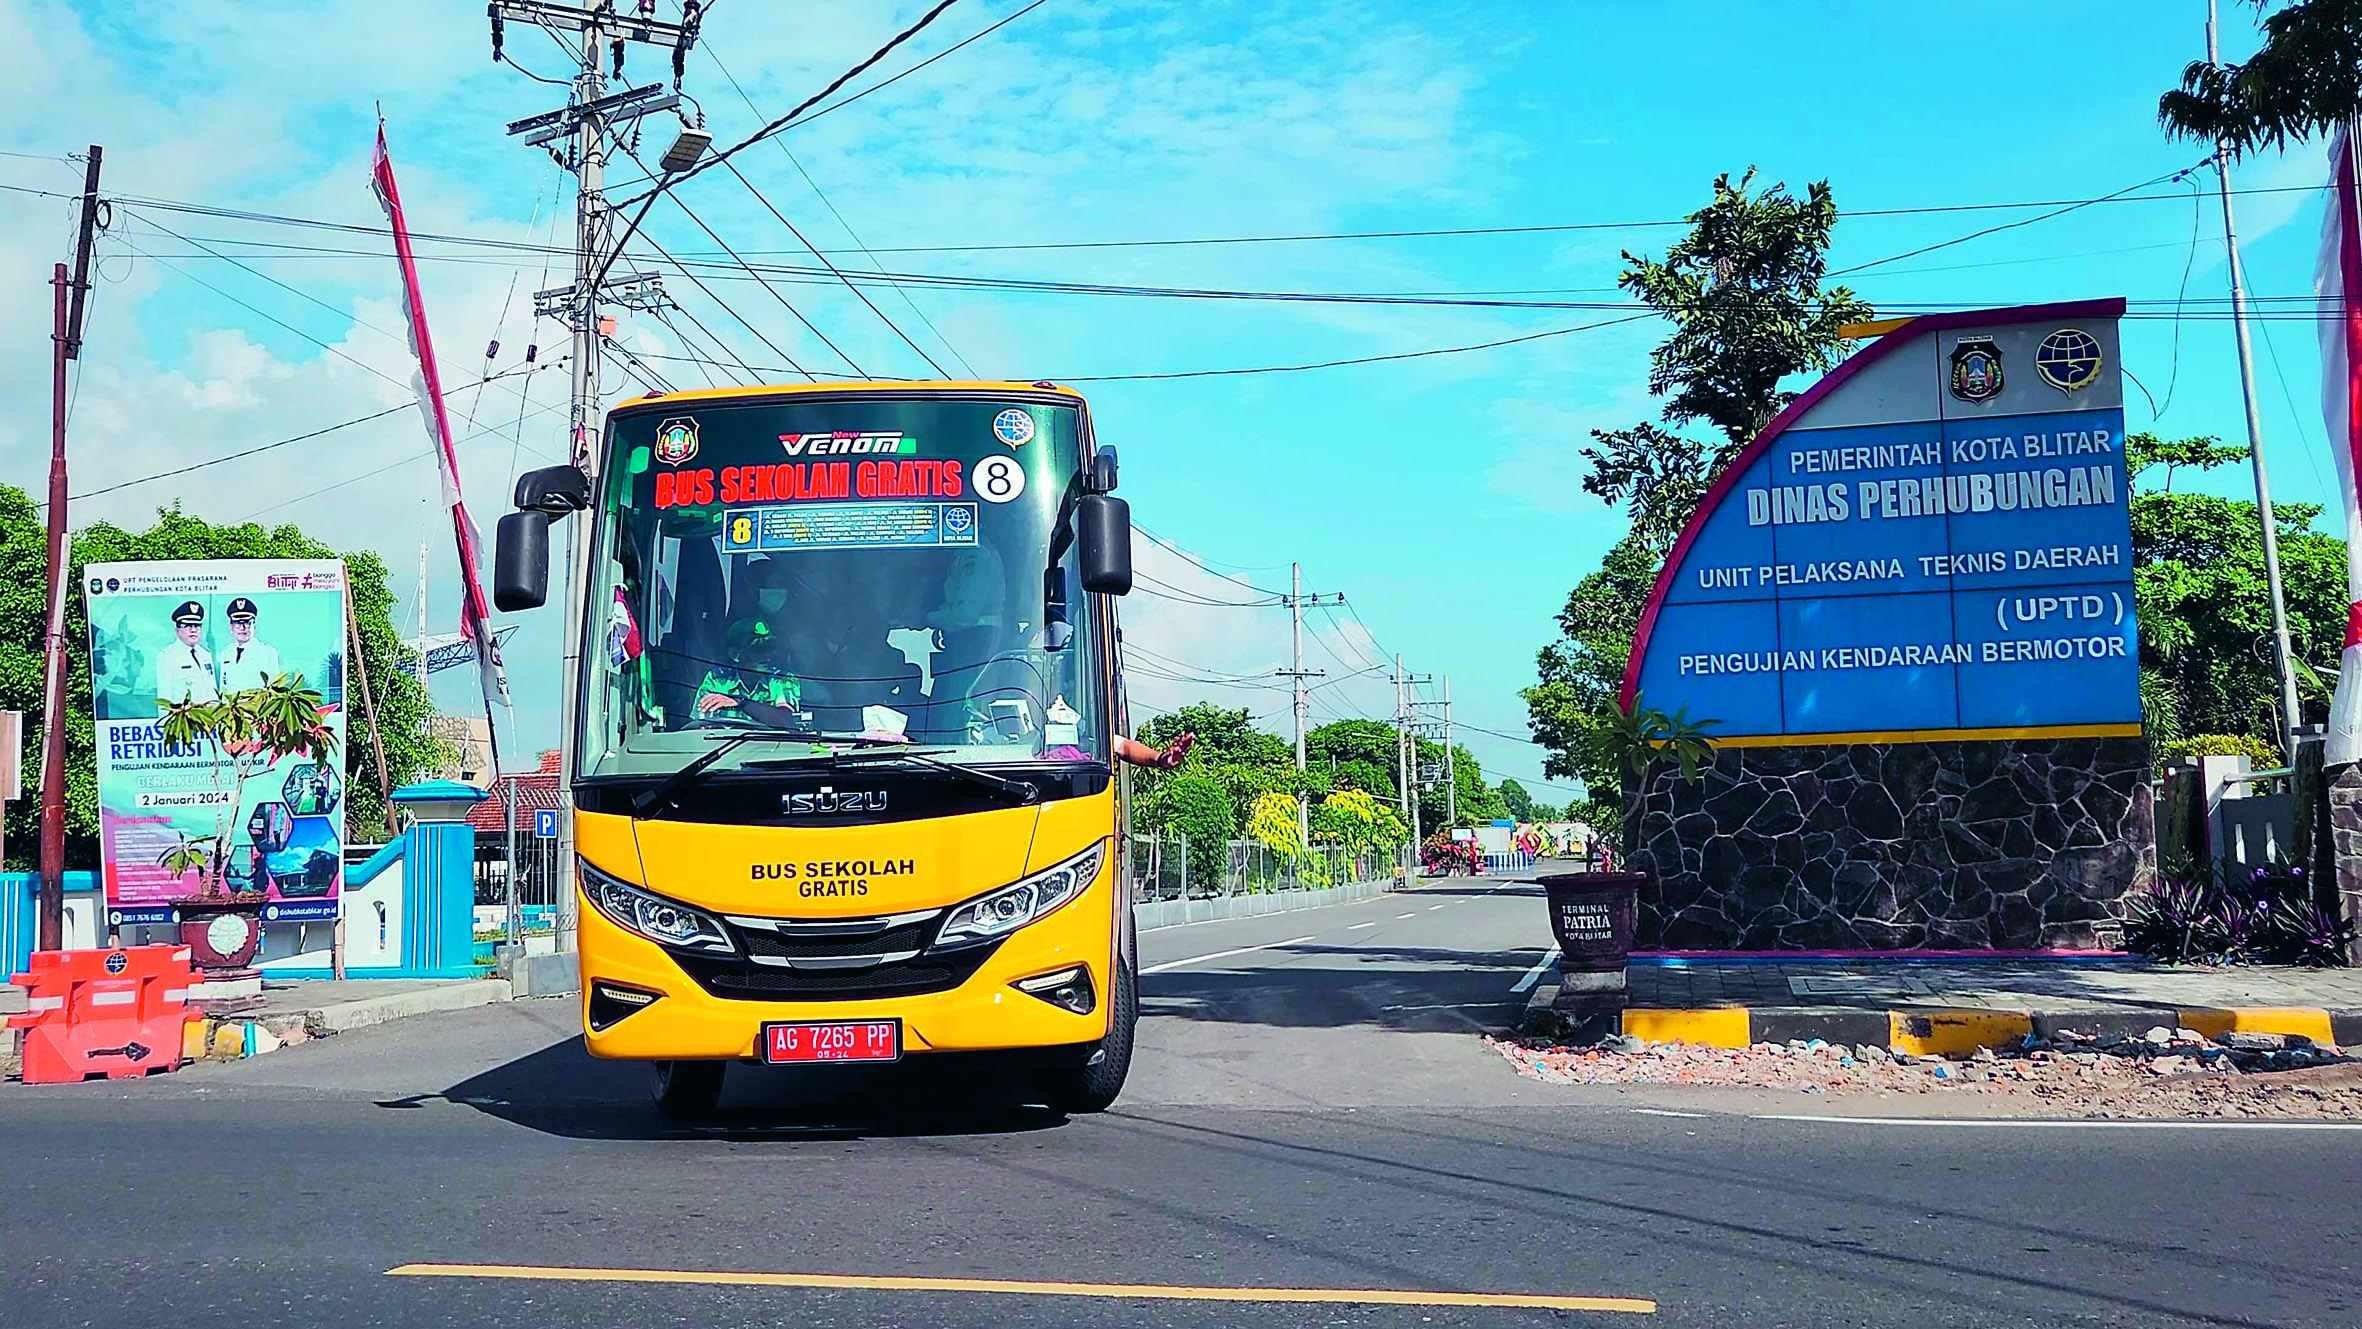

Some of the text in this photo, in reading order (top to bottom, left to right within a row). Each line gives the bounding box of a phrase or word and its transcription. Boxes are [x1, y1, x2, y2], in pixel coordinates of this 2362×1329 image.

[832, 431, 860, 439] New
[1791, 429, 2112, 474] PEMERINTAH KOTA BLITAR
[655, 460, 963, 509] BUS SEKOLAH GRATIS
[987, 462, 1012, 496] 8
[1747, 465, 2115, 527] DINAS PERHUBUNGAN
[732, 517, 753, 545] 8
[1699, 544, 2119, 589] UNIT PELAKSANA TEKNIS DAERAH
[1680, 636, 2126, 675] PENGUJIAN KENDARAAN BERMOTOR
[109, 725, 164, 743] BEBAS
[111, 763, 150, 771] PENGUJIAN
[151, 761, 195, 769] KENDARAAN
[137, 773, 235, 788] BERLAKU MUAI
[142, 796, 150, 806] 2
[153, 793, 195, 806] Januari
[782, 786, 888, 814] ISUZU
[541, 814, 552, 829] P
[751, 859, 914, 880] BUS SEKOLAH
[799, 879, 868, 897] GRATIS
[1562, 904, 1609, 914] TERMINAL
[1563, 915, 1611, 929] PATRIA
[776, 1025, 889, 1050] AG 7265 PP
